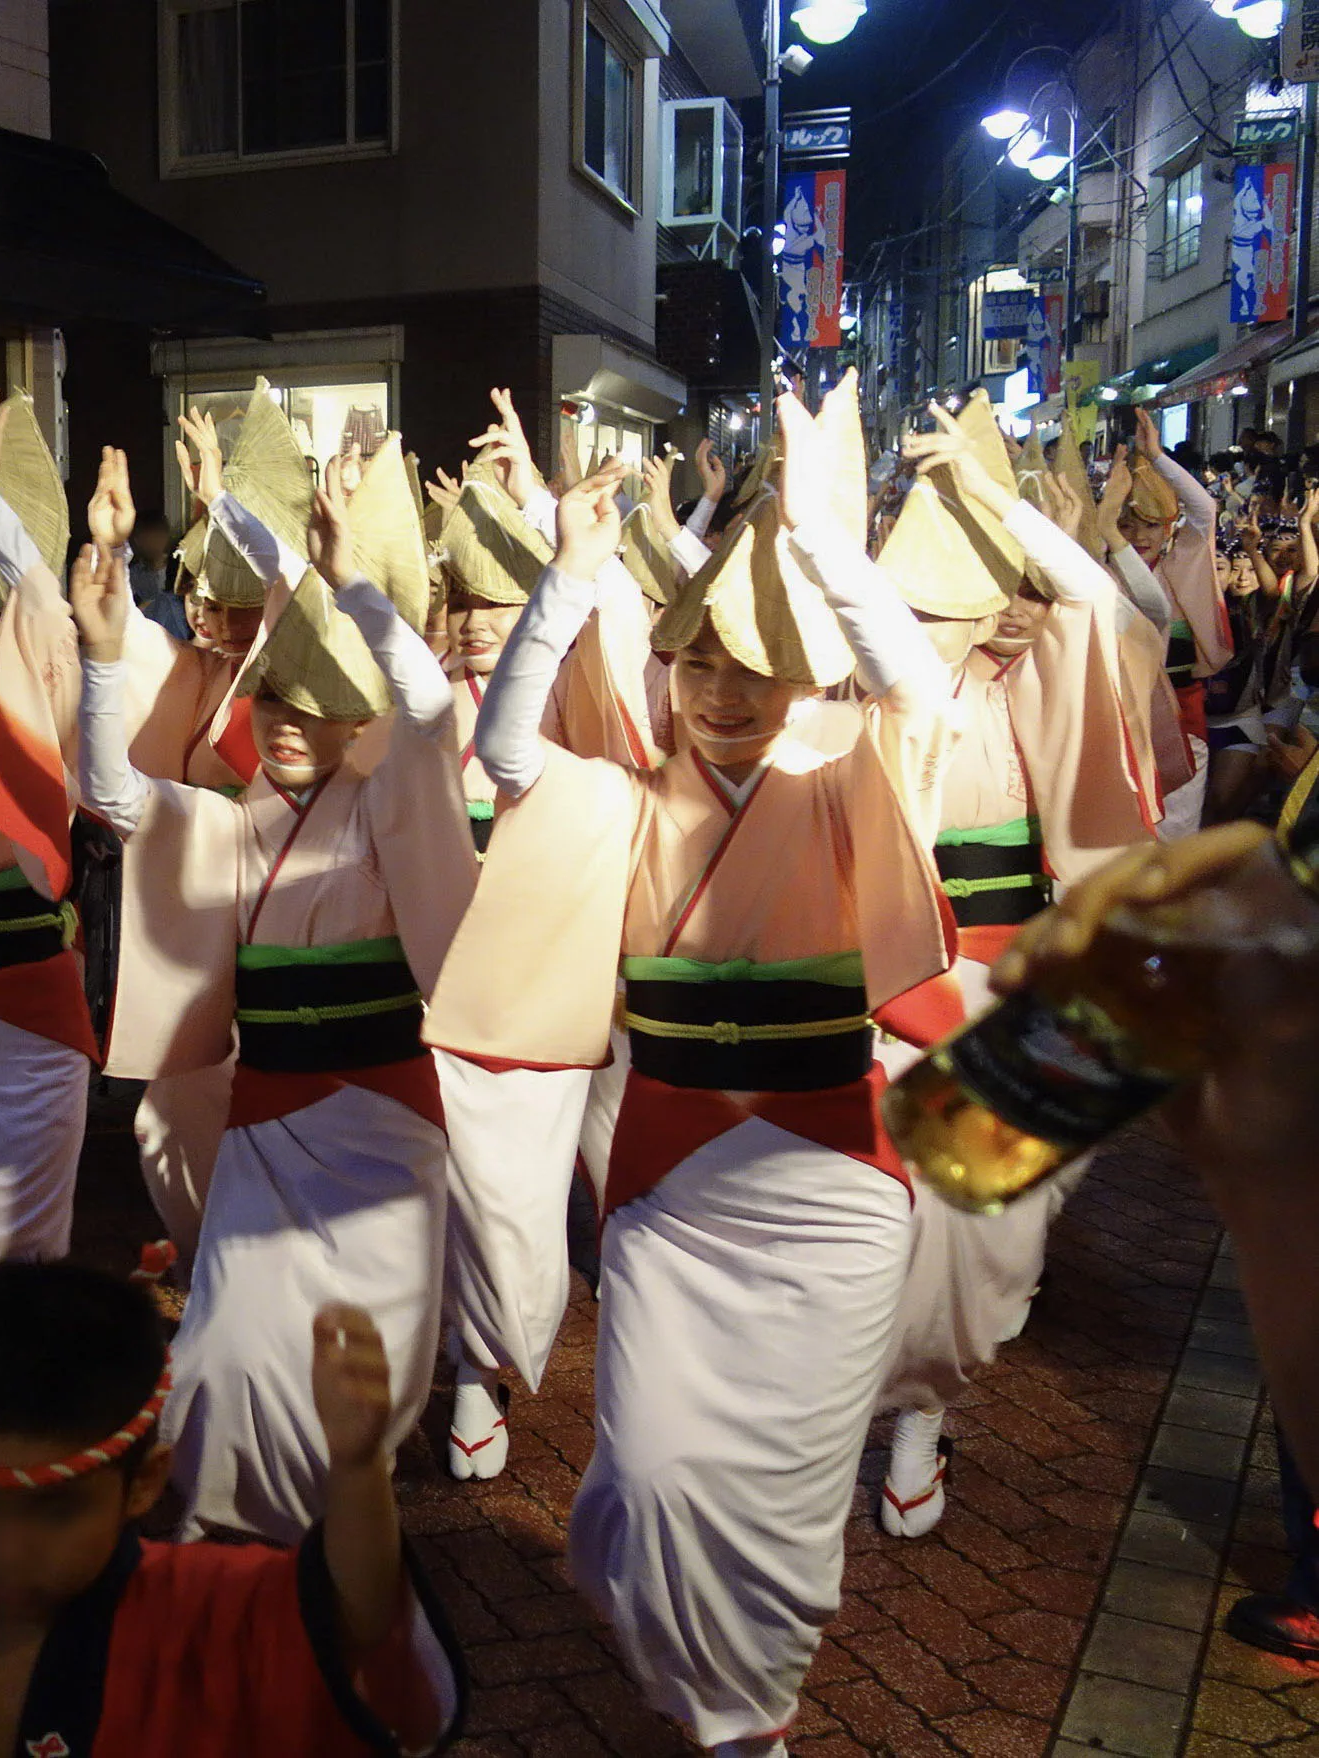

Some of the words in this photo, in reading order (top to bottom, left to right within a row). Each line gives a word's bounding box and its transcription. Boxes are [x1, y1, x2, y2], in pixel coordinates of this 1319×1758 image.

[789, 125, 844, 146] ルック
[1239, 121, 1292, 141] ルック
